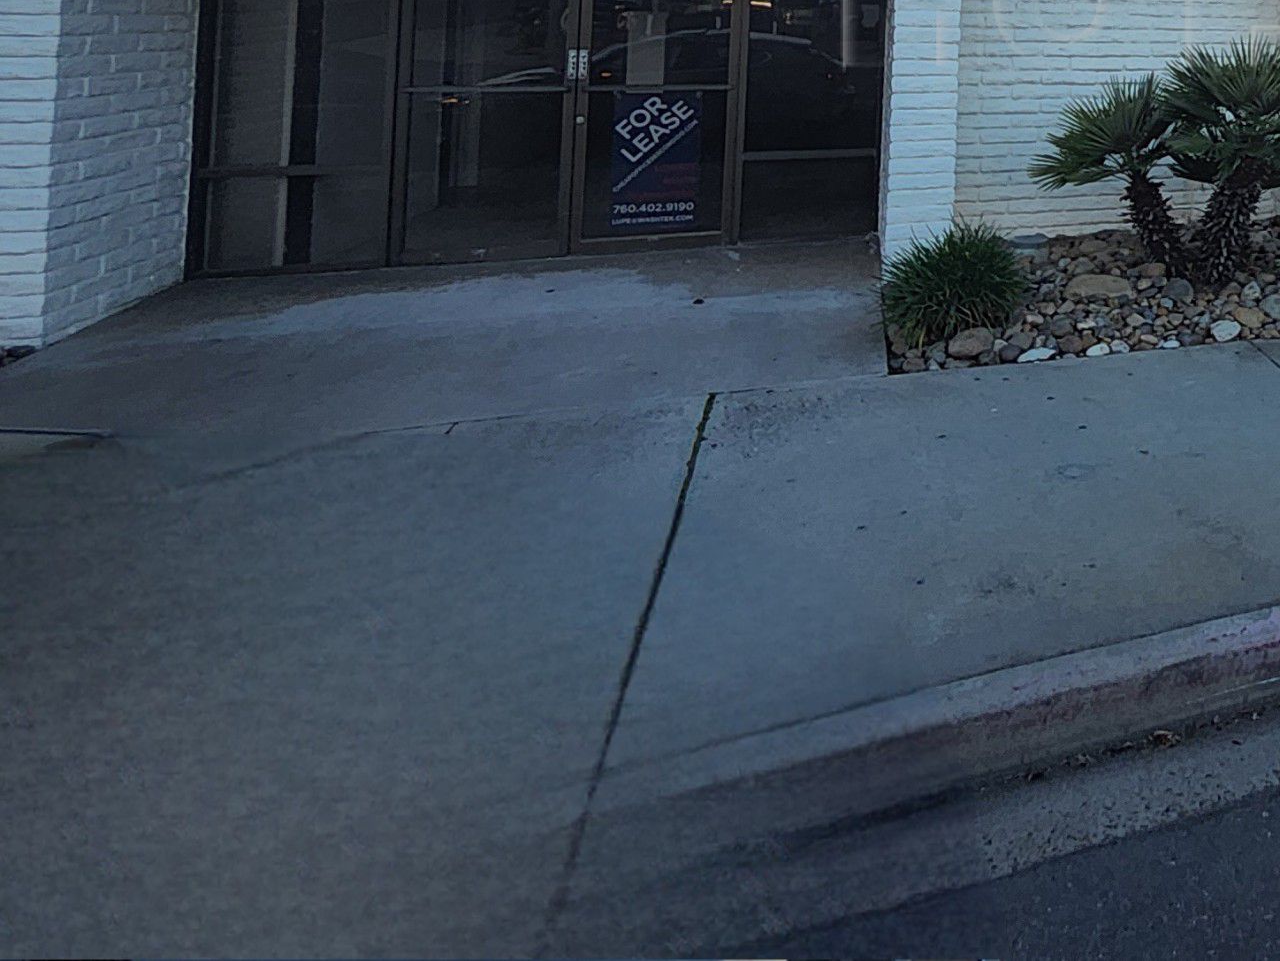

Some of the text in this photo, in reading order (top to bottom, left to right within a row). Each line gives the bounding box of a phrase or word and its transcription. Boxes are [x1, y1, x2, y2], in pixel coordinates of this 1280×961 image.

[614, 96, 668, 140] FOR
[620, 100, 695, 163] LEASE
[613, 202, 694, 213] 760.402.9190
